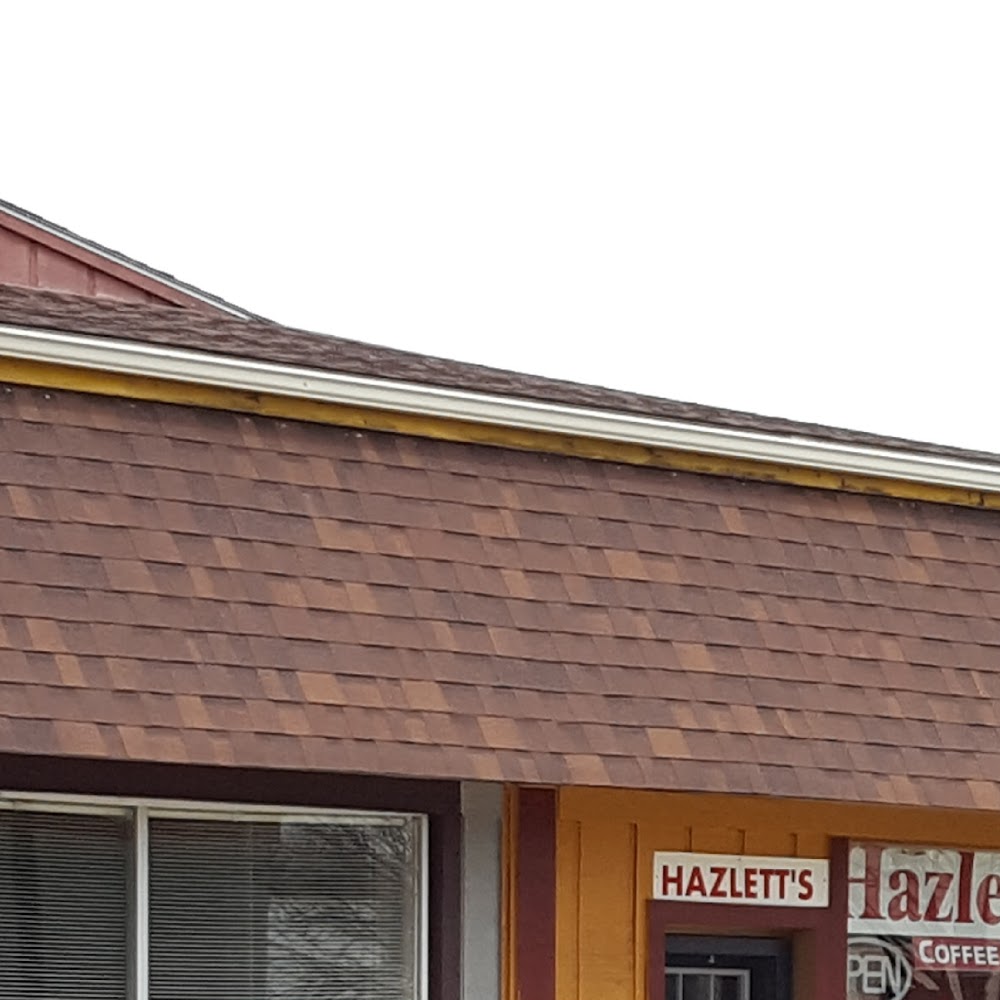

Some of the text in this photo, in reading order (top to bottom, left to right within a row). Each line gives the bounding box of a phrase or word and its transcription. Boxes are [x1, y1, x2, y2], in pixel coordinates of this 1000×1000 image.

[661, 865, 814, 900] HAZLETT'S
[918, 939, 1000, 966] COFFEE
[847, 954, 902, 994] PEN
